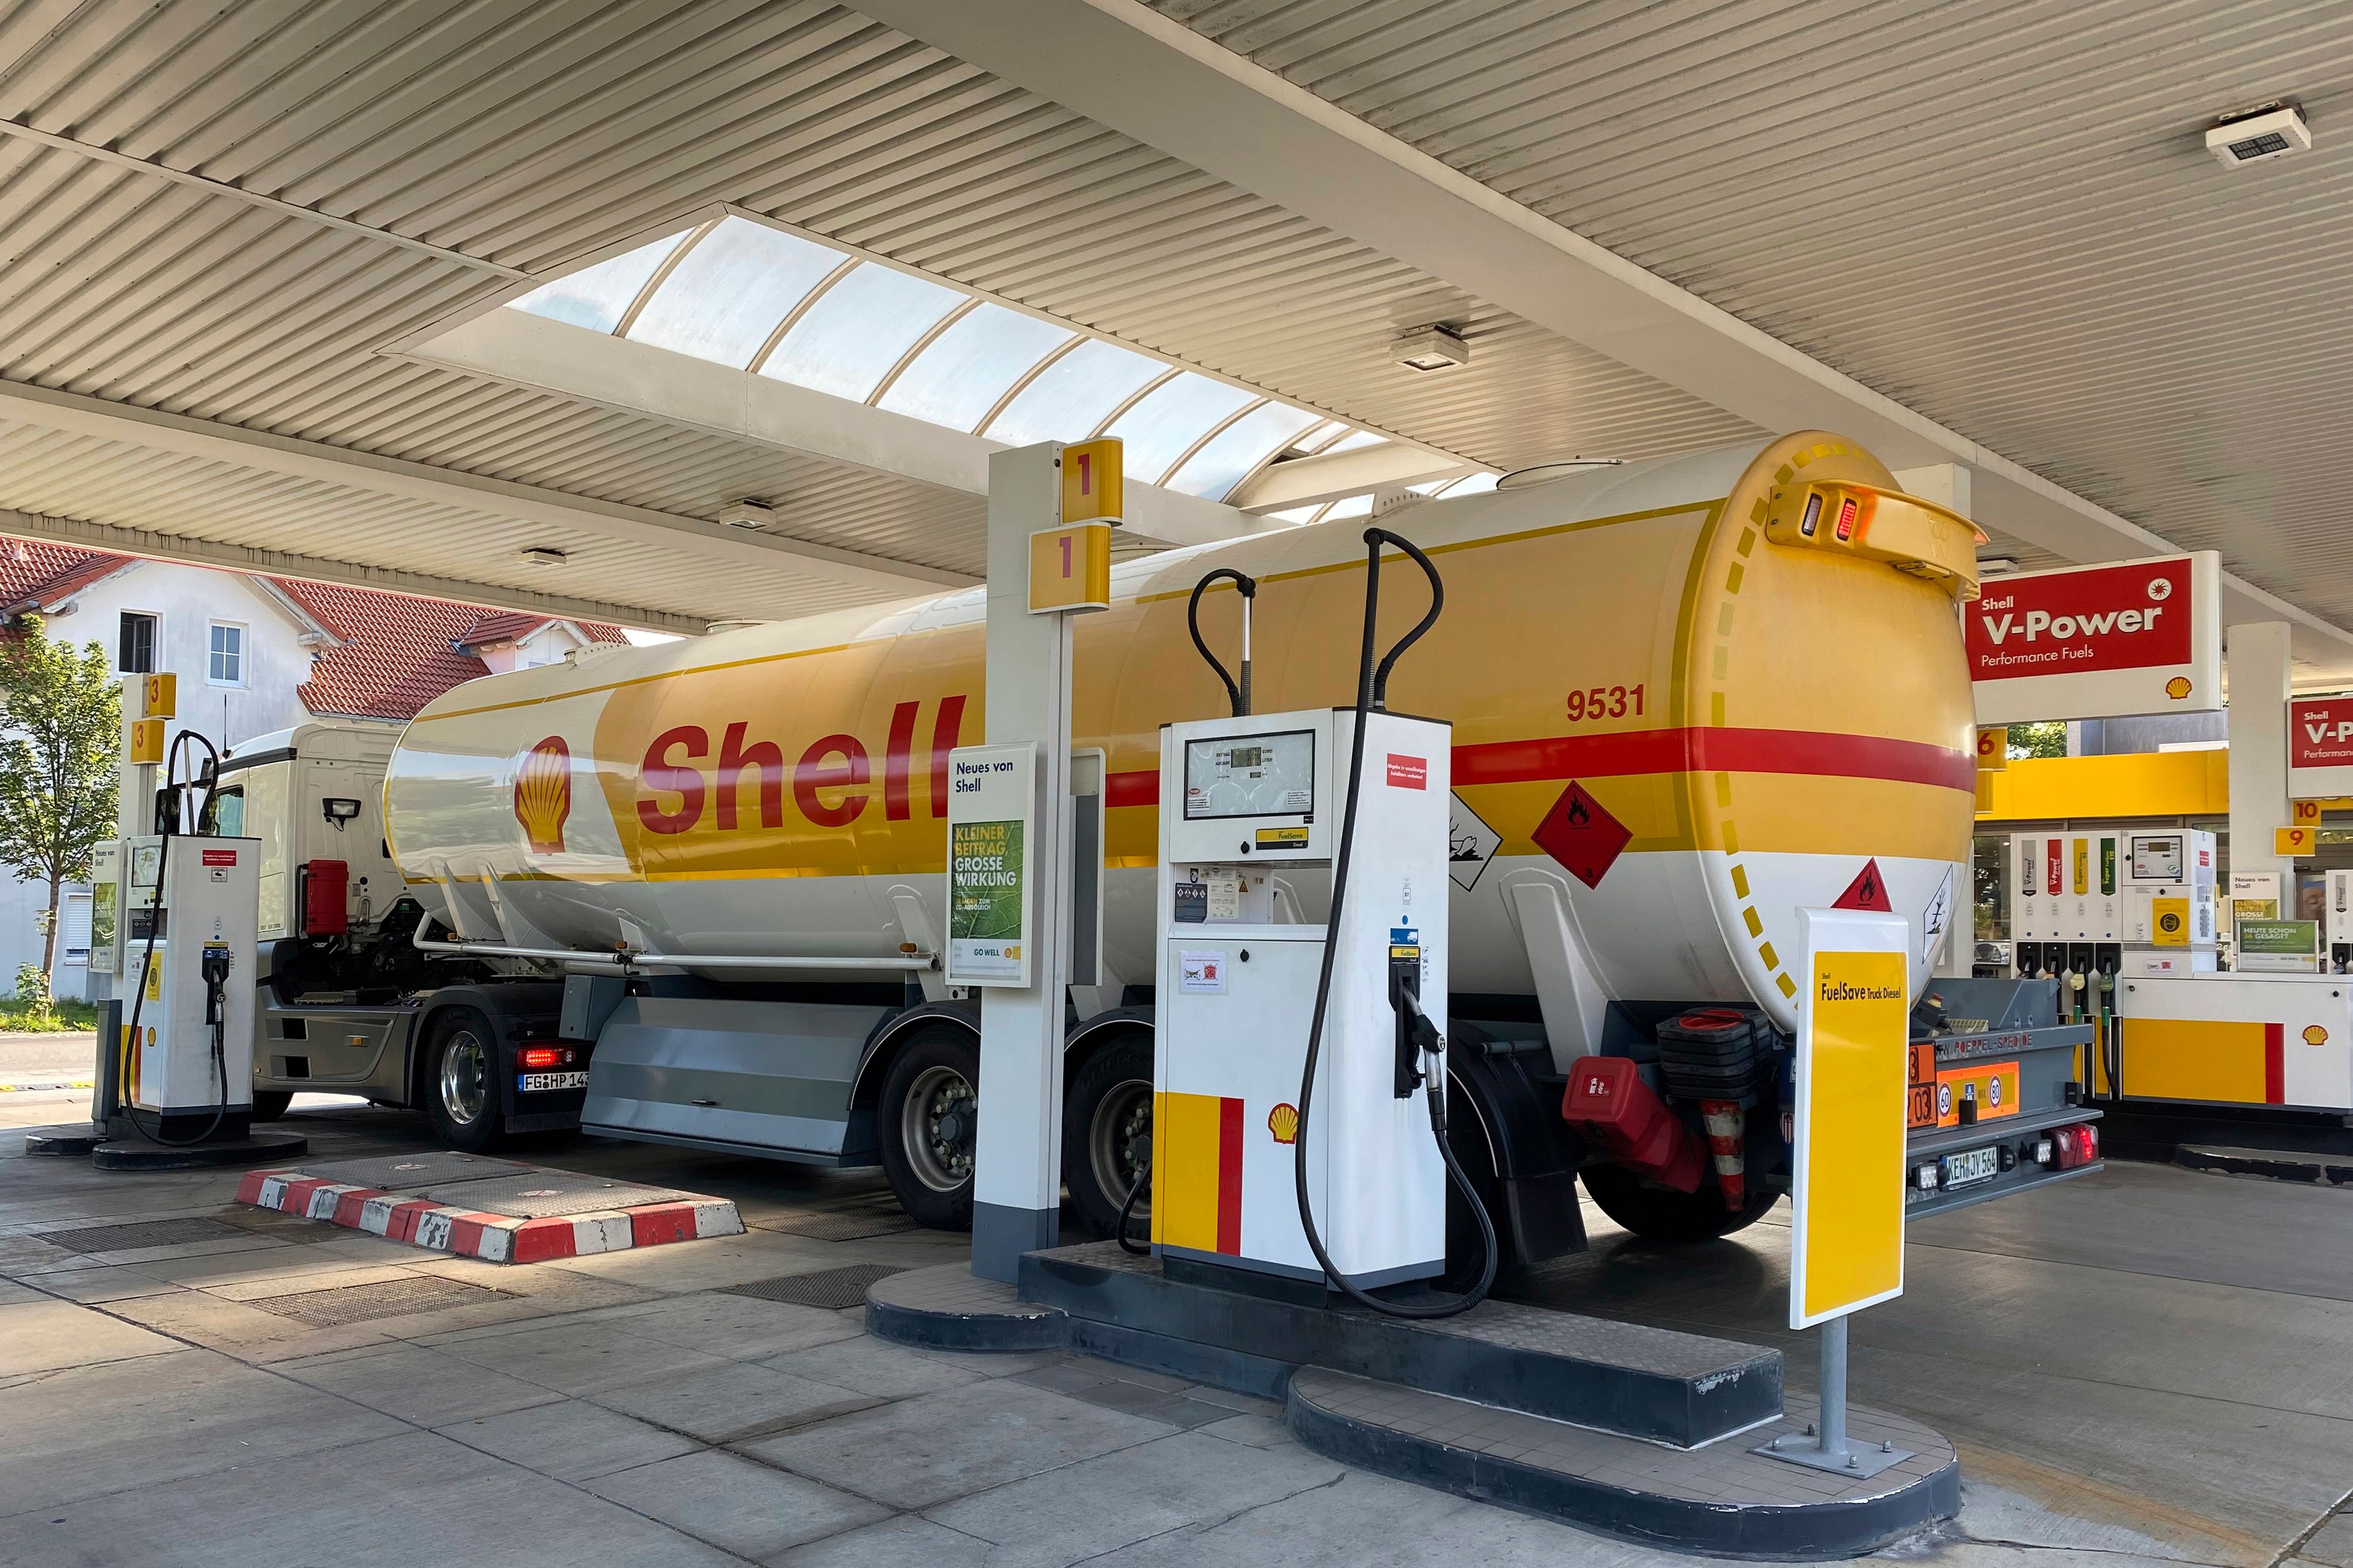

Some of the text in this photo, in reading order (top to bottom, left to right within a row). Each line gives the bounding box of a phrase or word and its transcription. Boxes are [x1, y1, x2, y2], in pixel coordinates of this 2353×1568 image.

[1078, 453, 1090, 495] 1
[1059, 536, 1072, 578] 1
[1982, 595, 2014, 610] Shell
[1982, 606, 2163, 645] V-Power
[1982, 644, 2094, 667] Performance Fuels
[151, 680, 159, 703] 3
[1567, 683, 1645, 722] 9531
[2304, 710, 2329, 720] Shell
[136, 725, 145, 748] 3
[1977, 732, 1995, 756] 6
[636, 695, 968, 835] Shell
[956, 761, 1014, 775] Neues von
[956, 778, 981, 793] Shell
[2297, 802, 2318, 819] 10
[955, 825, 1005, 842] KLEINER
[2289, 829, 2304, 846] 9
[955, 841, 1006, 856] BEITRAG
[955, 856, 1003, 872] GROSSE
[955, 871, 1016, 887] WIRKUNG
[1584, 868, 1594, 879] 3
[1821, 980, 1901, 1001] FuelSave Truck Diesel
[525, 1075, 542, 1089] FG
[550, 1074, 566, 1088] HP
[1941, 1092, 1949, 1108] 60
[1992, 1085, 1999, 1099] 80
[1948, 1149, 1997, 1181] KEH JY 564
